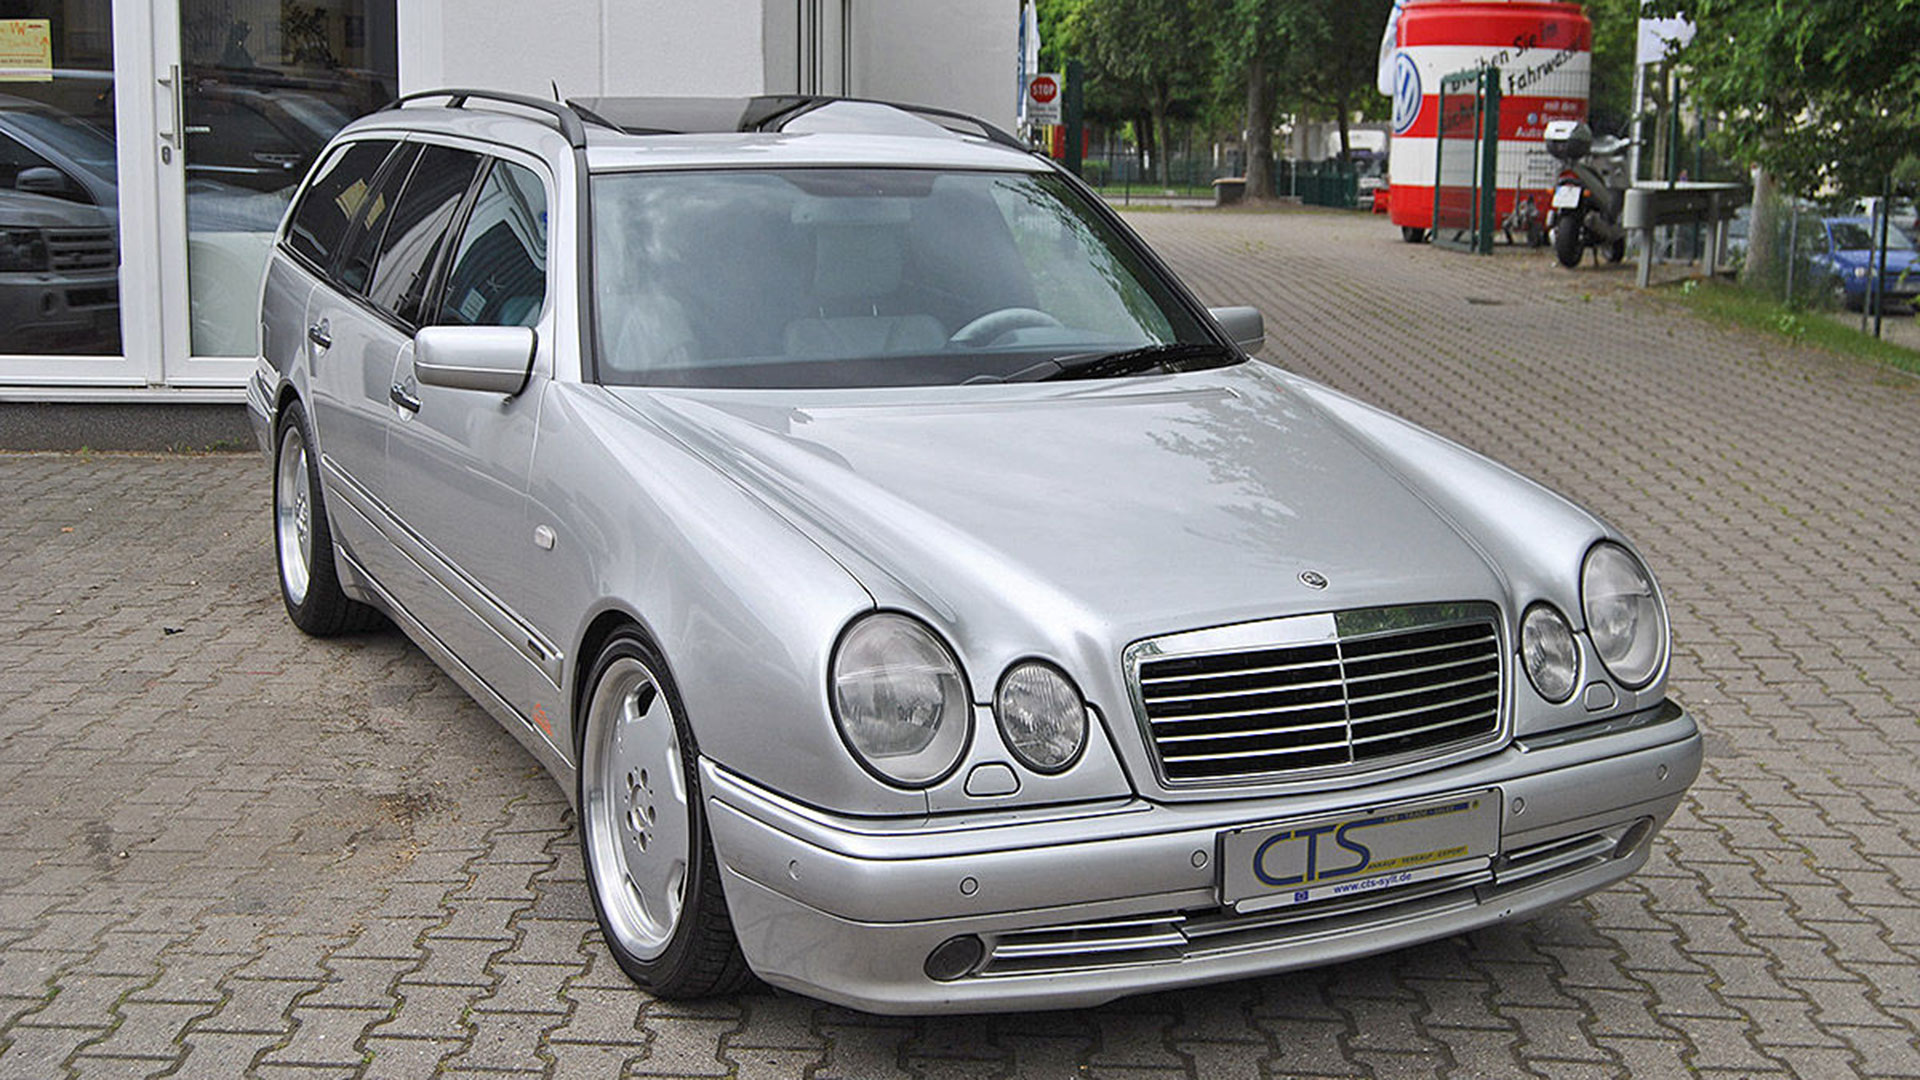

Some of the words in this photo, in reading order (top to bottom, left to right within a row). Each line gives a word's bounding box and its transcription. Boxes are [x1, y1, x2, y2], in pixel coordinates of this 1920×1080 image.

[1513, 33, 1536, 57] Sie
[1032, 83, 1055, 96] STOP
[1253, 819, 1372, 887] CTS
[1333, 873, 1412, 893] www.cts-sylt.de
